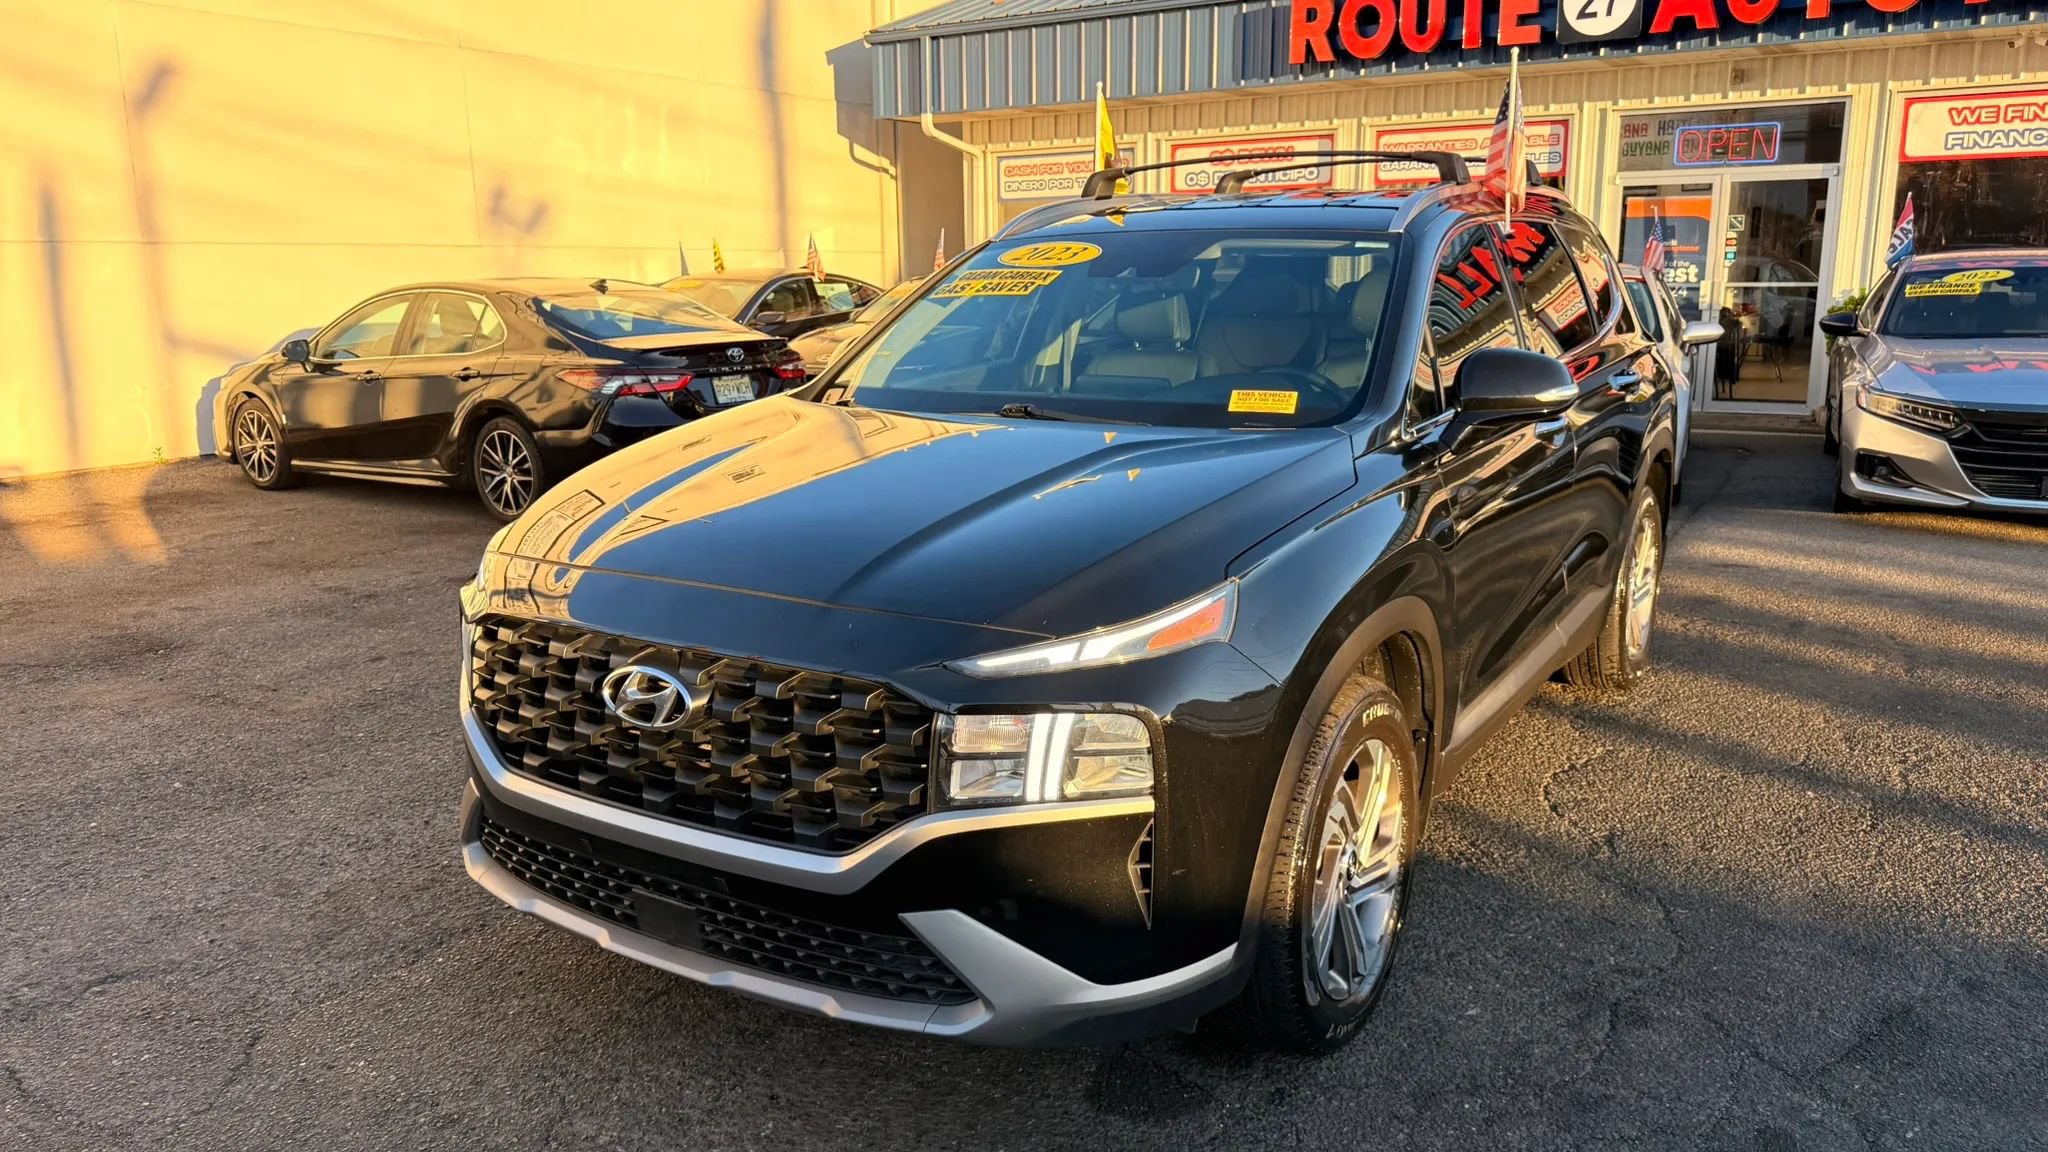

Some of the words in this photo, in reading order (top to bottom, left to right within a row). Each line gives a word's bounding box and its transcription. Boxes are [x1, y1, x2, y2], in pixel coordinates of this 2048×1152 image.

[1948, 104, 2001, 126] WE
[1678, 127, 1777, 163] OPEN
[1944, 127, 2048, 150] FINANC
[1622, 140, 1670, 157] GUYANA
[1005, 162, 1037, 177] CASH
[1039, 161, 1064, 175] FOR
[1005, 179, 1046, 193] DINERO
[1048, 178, 1073, 191] POR
[1011, 246, 1089, 261] 2023
[959, 270, 1000, 281] CLEAN
[1001, 270, 1053, 281] CARFAX
[1663, 264, 1699, 283] est
[1957, 271, 2000, 282] 2022
[935, 283, 967, 295] GAS
[976, 281, 1033, 293] SAVER
